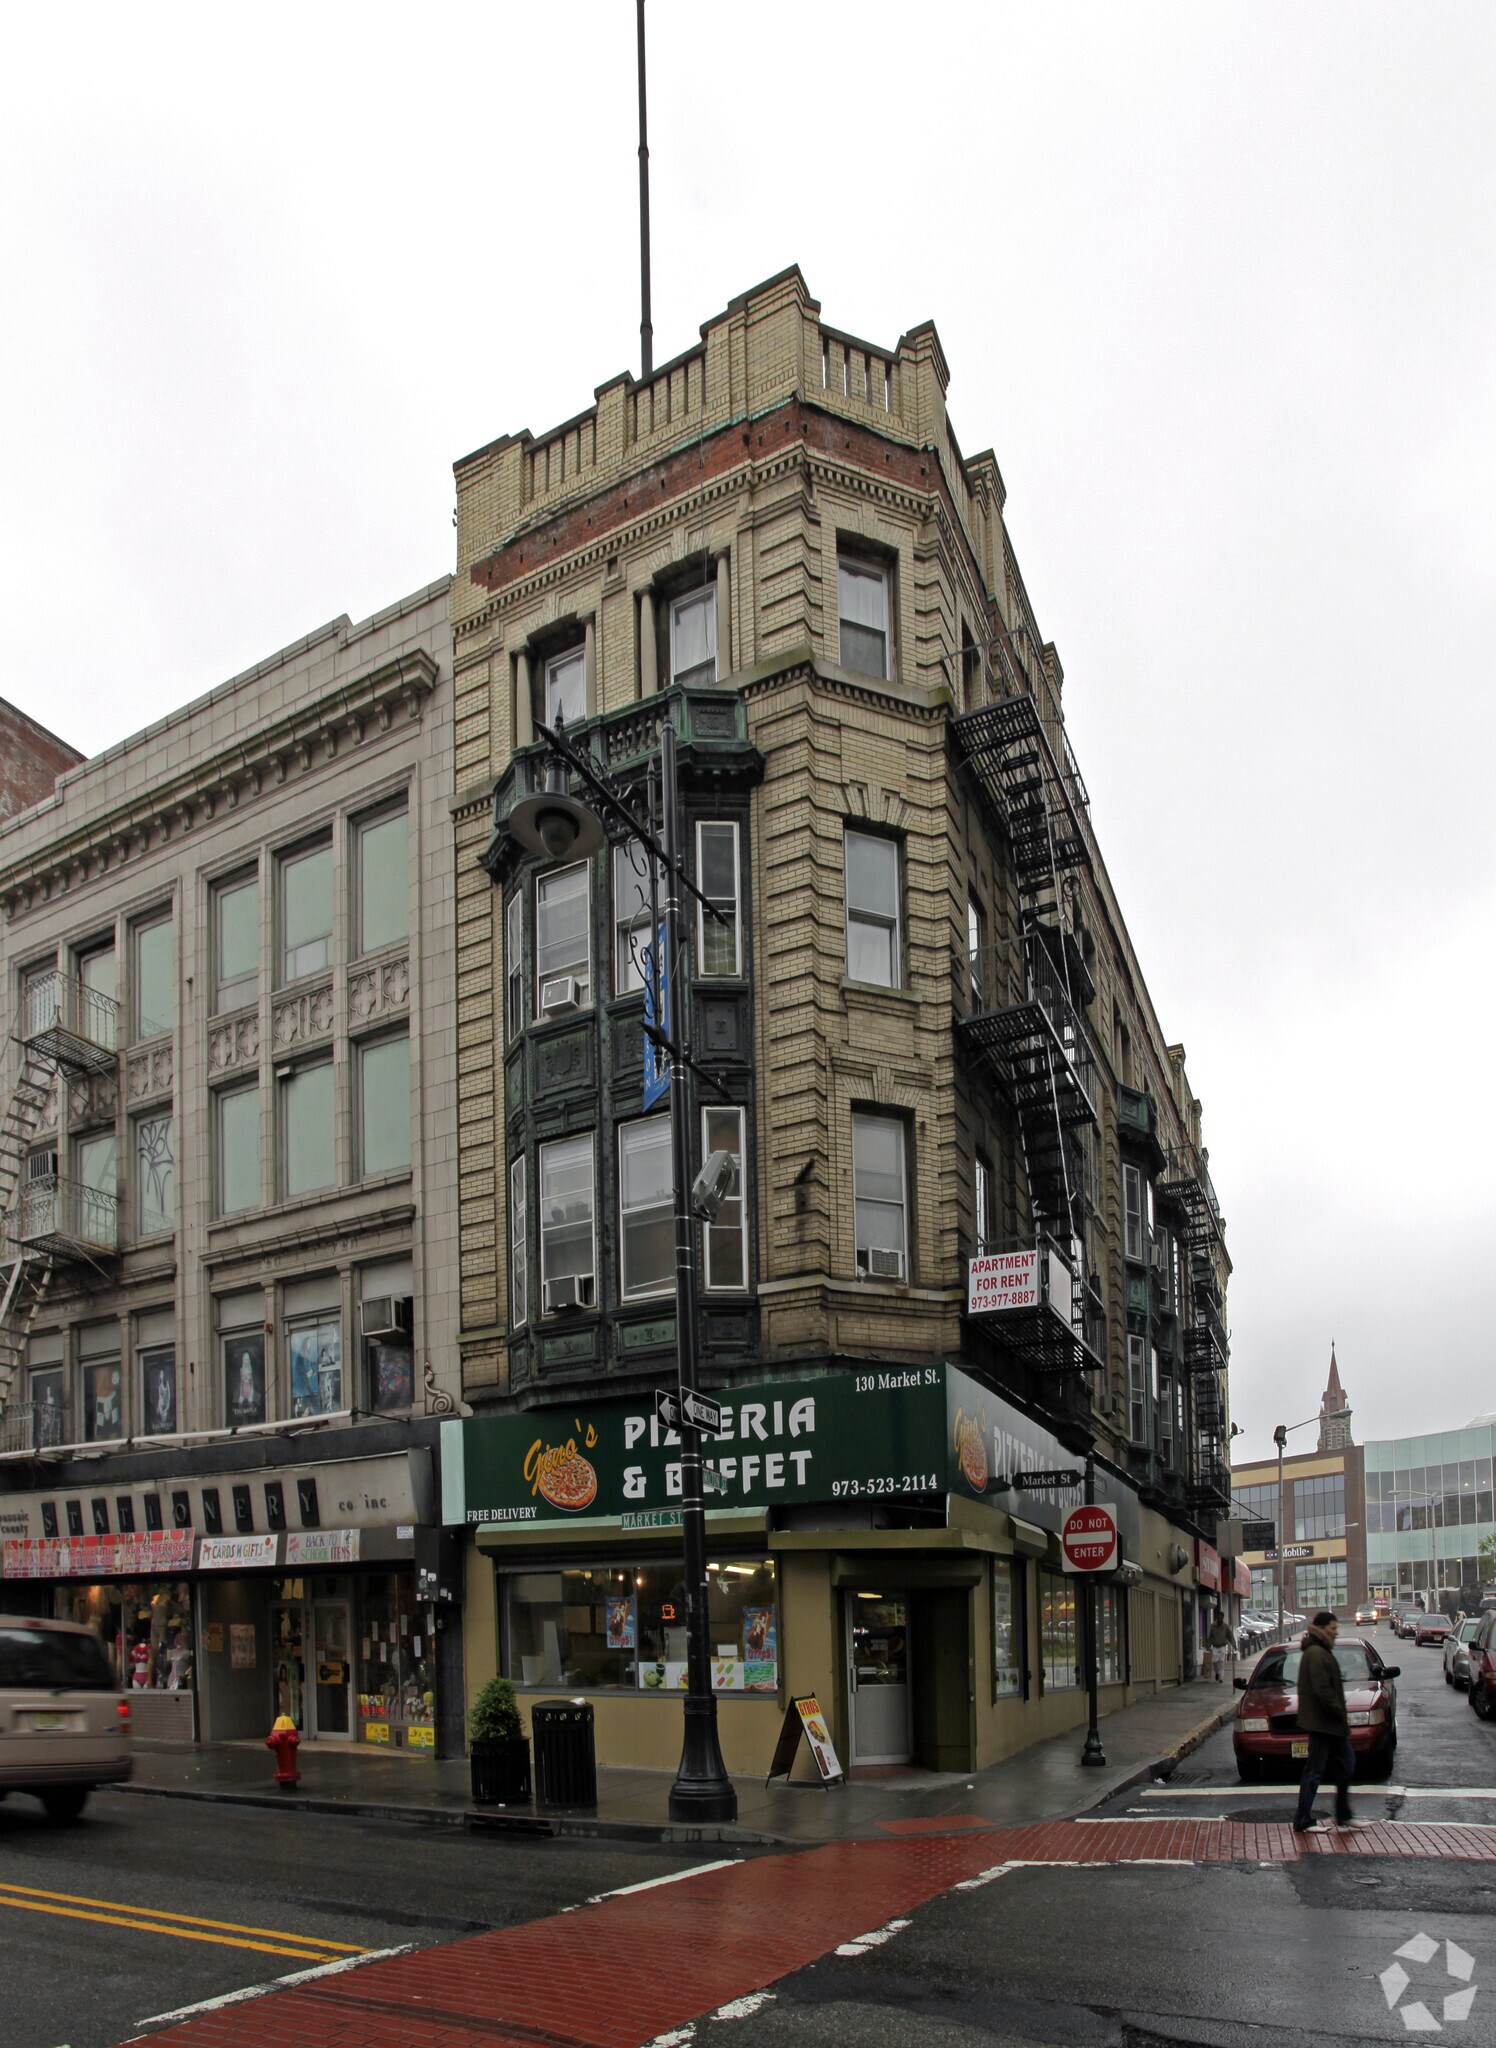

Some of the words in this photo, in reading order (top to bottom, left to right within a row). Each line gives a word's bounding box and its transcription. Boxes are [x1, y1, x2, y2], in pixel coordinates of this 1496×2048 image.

[971, 1253, 1036, 1274] APARTMENT
[976, 1277, 998, 1291] FOR
[1001, 1272, 1030, 1288] RENT
[971, 1290, 1035, 1309] 973-977-8887
[855, 1375, 875, 1392] 130
[878, 1370, 921, 1390] Market
[925, 1368, 941, 1384] St.
[693, 1403, 704, 1419] ONE
[706, 1407, 718, 1424] WAY
[523, 1417, 599, 1497] Gino's
[622, 1465, 647, 1499] &
[831, 1473, 938, 1497] 973-523-2114
[1022, 1475, 1056, 1486] Market
[1060, 1473, 1071, 1484] St
[43, 1490, 314, 1532] STATIONERY
[467, 1509, 489, 1522] FREE
[491, 1506, 538, 1521] DELIVERY
[623, 1513, 664, 1528] MARKET
[1070, 1519, 1083, 1531] DO
[1088, 1517, 1108, 1529] NOT
[1, 1523, 29, 1538] county
[143, 1541, 191, 1554] ENTERPRISE
[305, 1535, 325, 1548] BACK
[328, 1532, 338, 1547] TO
[212, 1544, 236, 1559] CARDS
[243, 1543, 264, 1558] GIFTS
[300, 1546, 330, 1561] SCHOOL
[330, 1545, 352, 1561] ITEMS
[1074, 1546, 1105, 1559] ENTER
[798, 1700, 821, 1717] GYROS
